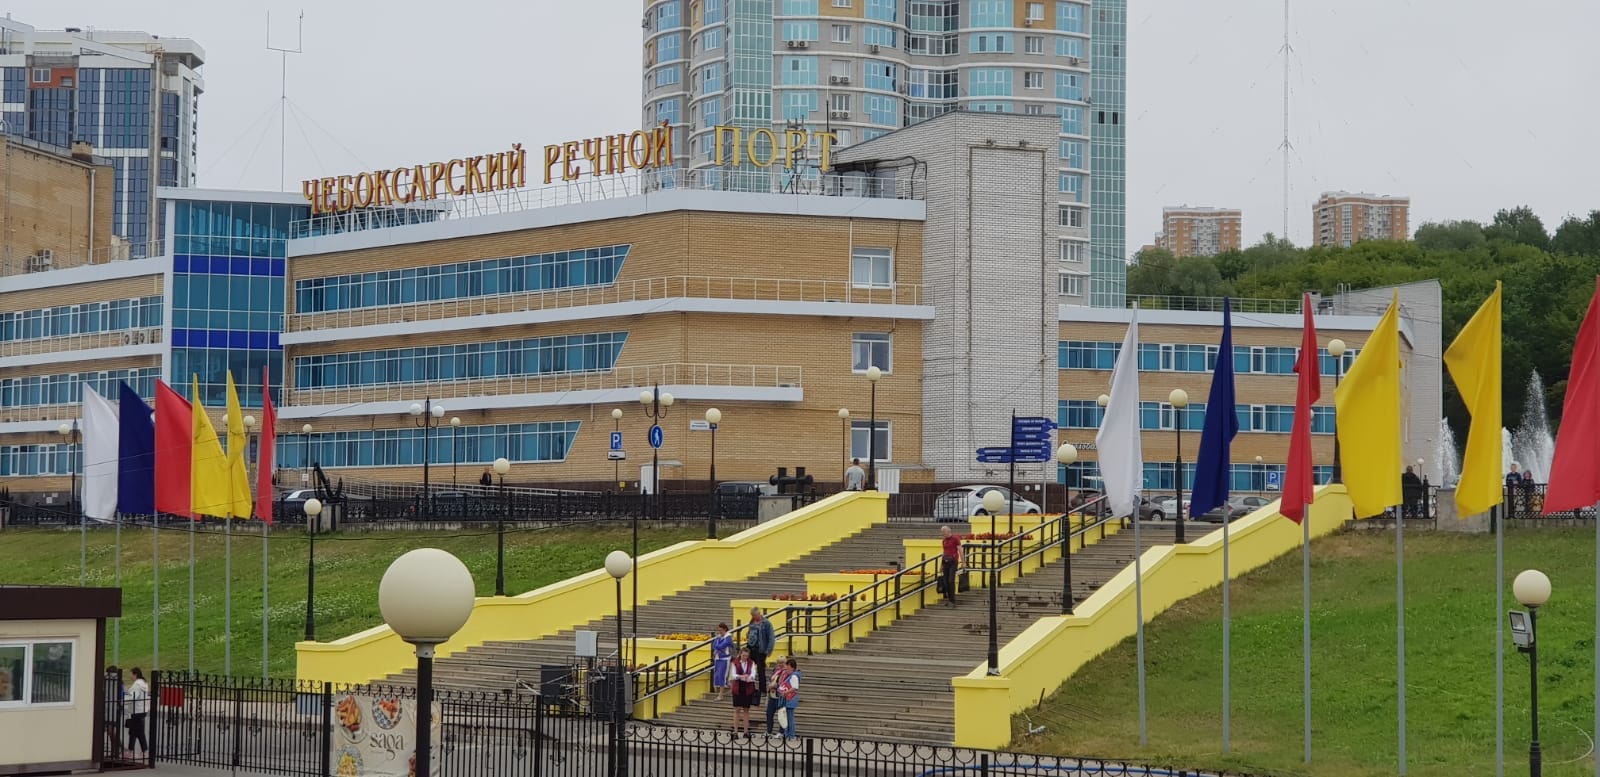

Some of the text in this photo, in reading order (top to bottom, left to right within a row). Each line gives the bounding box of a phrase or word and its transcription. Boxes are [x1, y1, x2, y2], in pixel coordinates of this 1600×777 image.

[302, 119, 838, 214] ЧЕБОКСАРСКИЙ РЕЧНОЙ ПОРТ
[613, 434, 620, 448] P
[369, 733, 404, 760] saga
